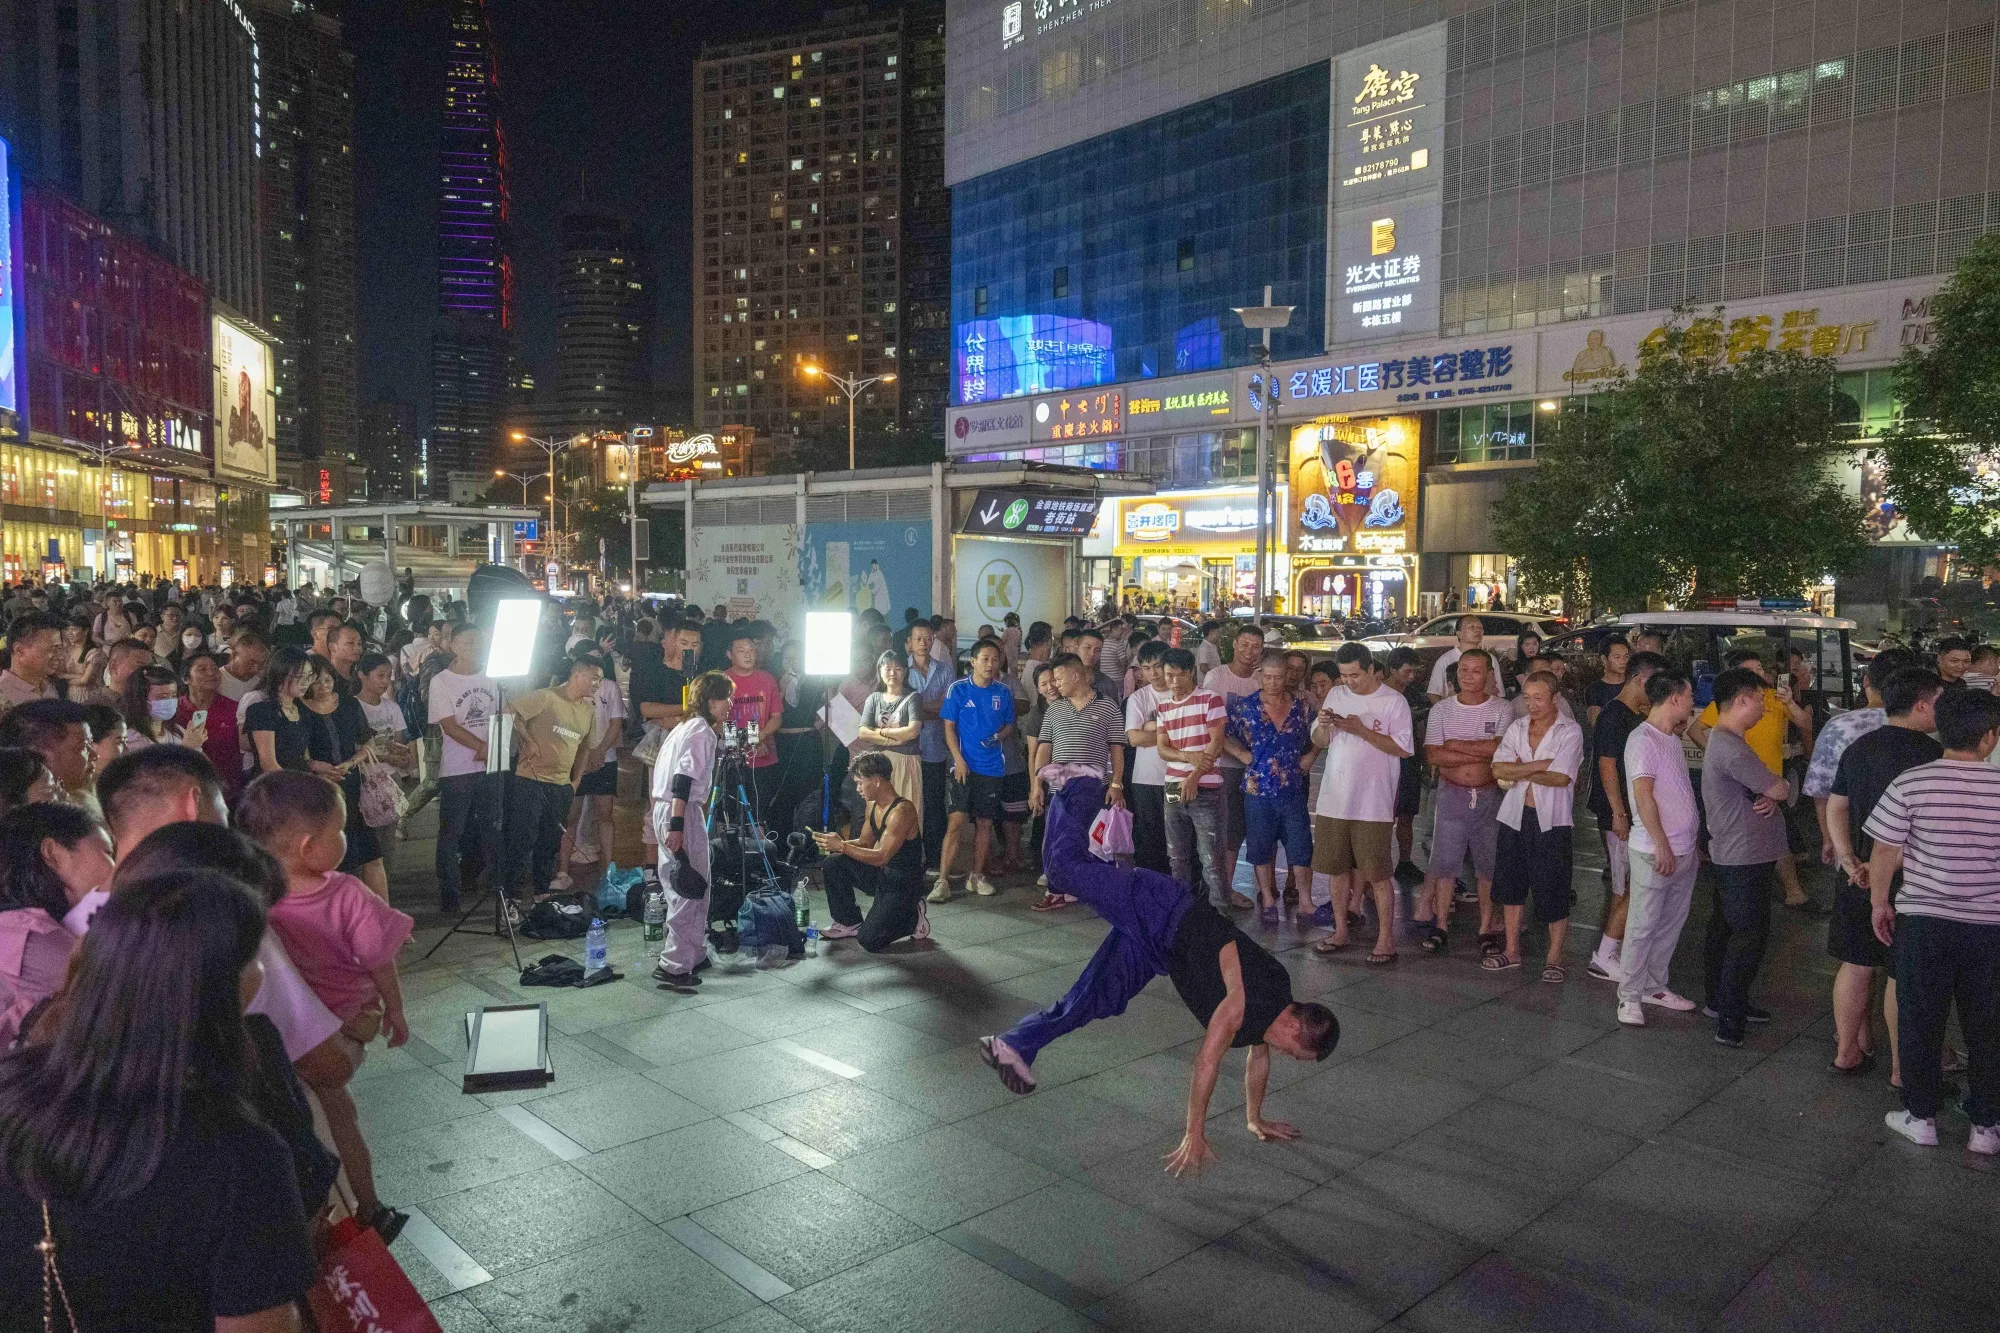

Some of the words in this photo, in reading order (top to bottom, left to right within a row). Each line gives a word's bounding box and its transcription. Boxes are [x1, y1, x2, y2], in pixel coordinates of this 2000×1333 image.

[1037, 8, 1083, 35] SHENZHEN
[1352, 105, 1370, 115] Tang
[1372, 97, 1396, 110] Palace
[1363, 158, 1399, 173] 82178790
[1346, 255, 1420, 285] 光大证券
[1346, 281, 1383, 294] EVERBRIGHT
[1385, 275, 1420, 288] SECURITIES
[1288, 345, 1513, 398] 名媛汇医疗美容整形
[1052, 419, 1113, 439] 重慶老火鍋
[1044, 512, 1077, 524] 老街站
[462, 690, 472, 699] ART
